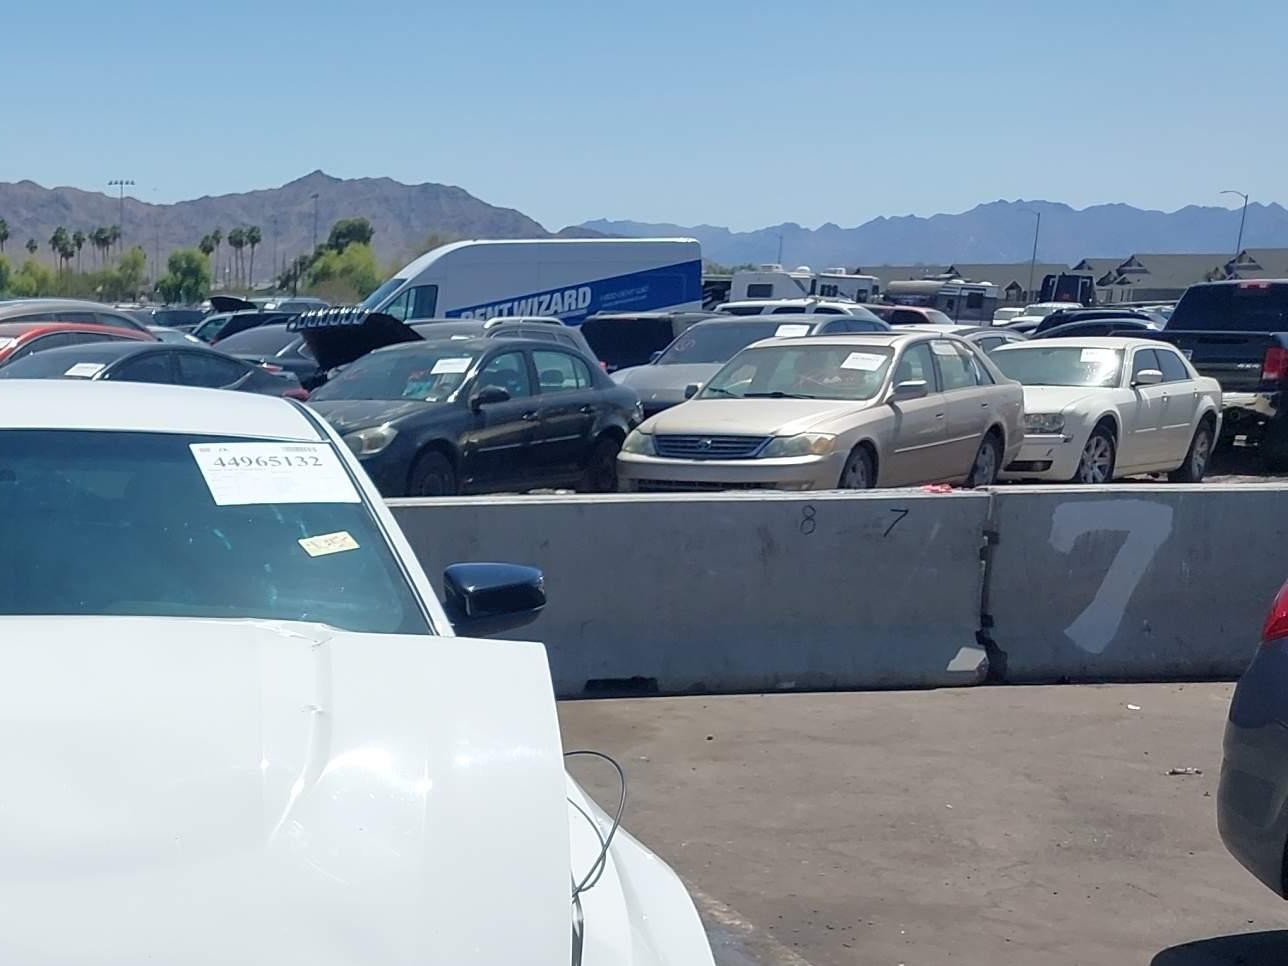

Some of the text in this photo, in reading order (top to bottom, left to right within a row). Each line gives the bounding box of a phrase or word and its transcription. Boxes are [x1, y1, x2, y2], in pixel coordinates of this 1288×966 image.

[513, 286, 592, 318] WIZARD
[214, 456, 323, 467] 44965132
[800, 505, 909, 537] 8 7
[1048, 499, 1174, 654] 7
